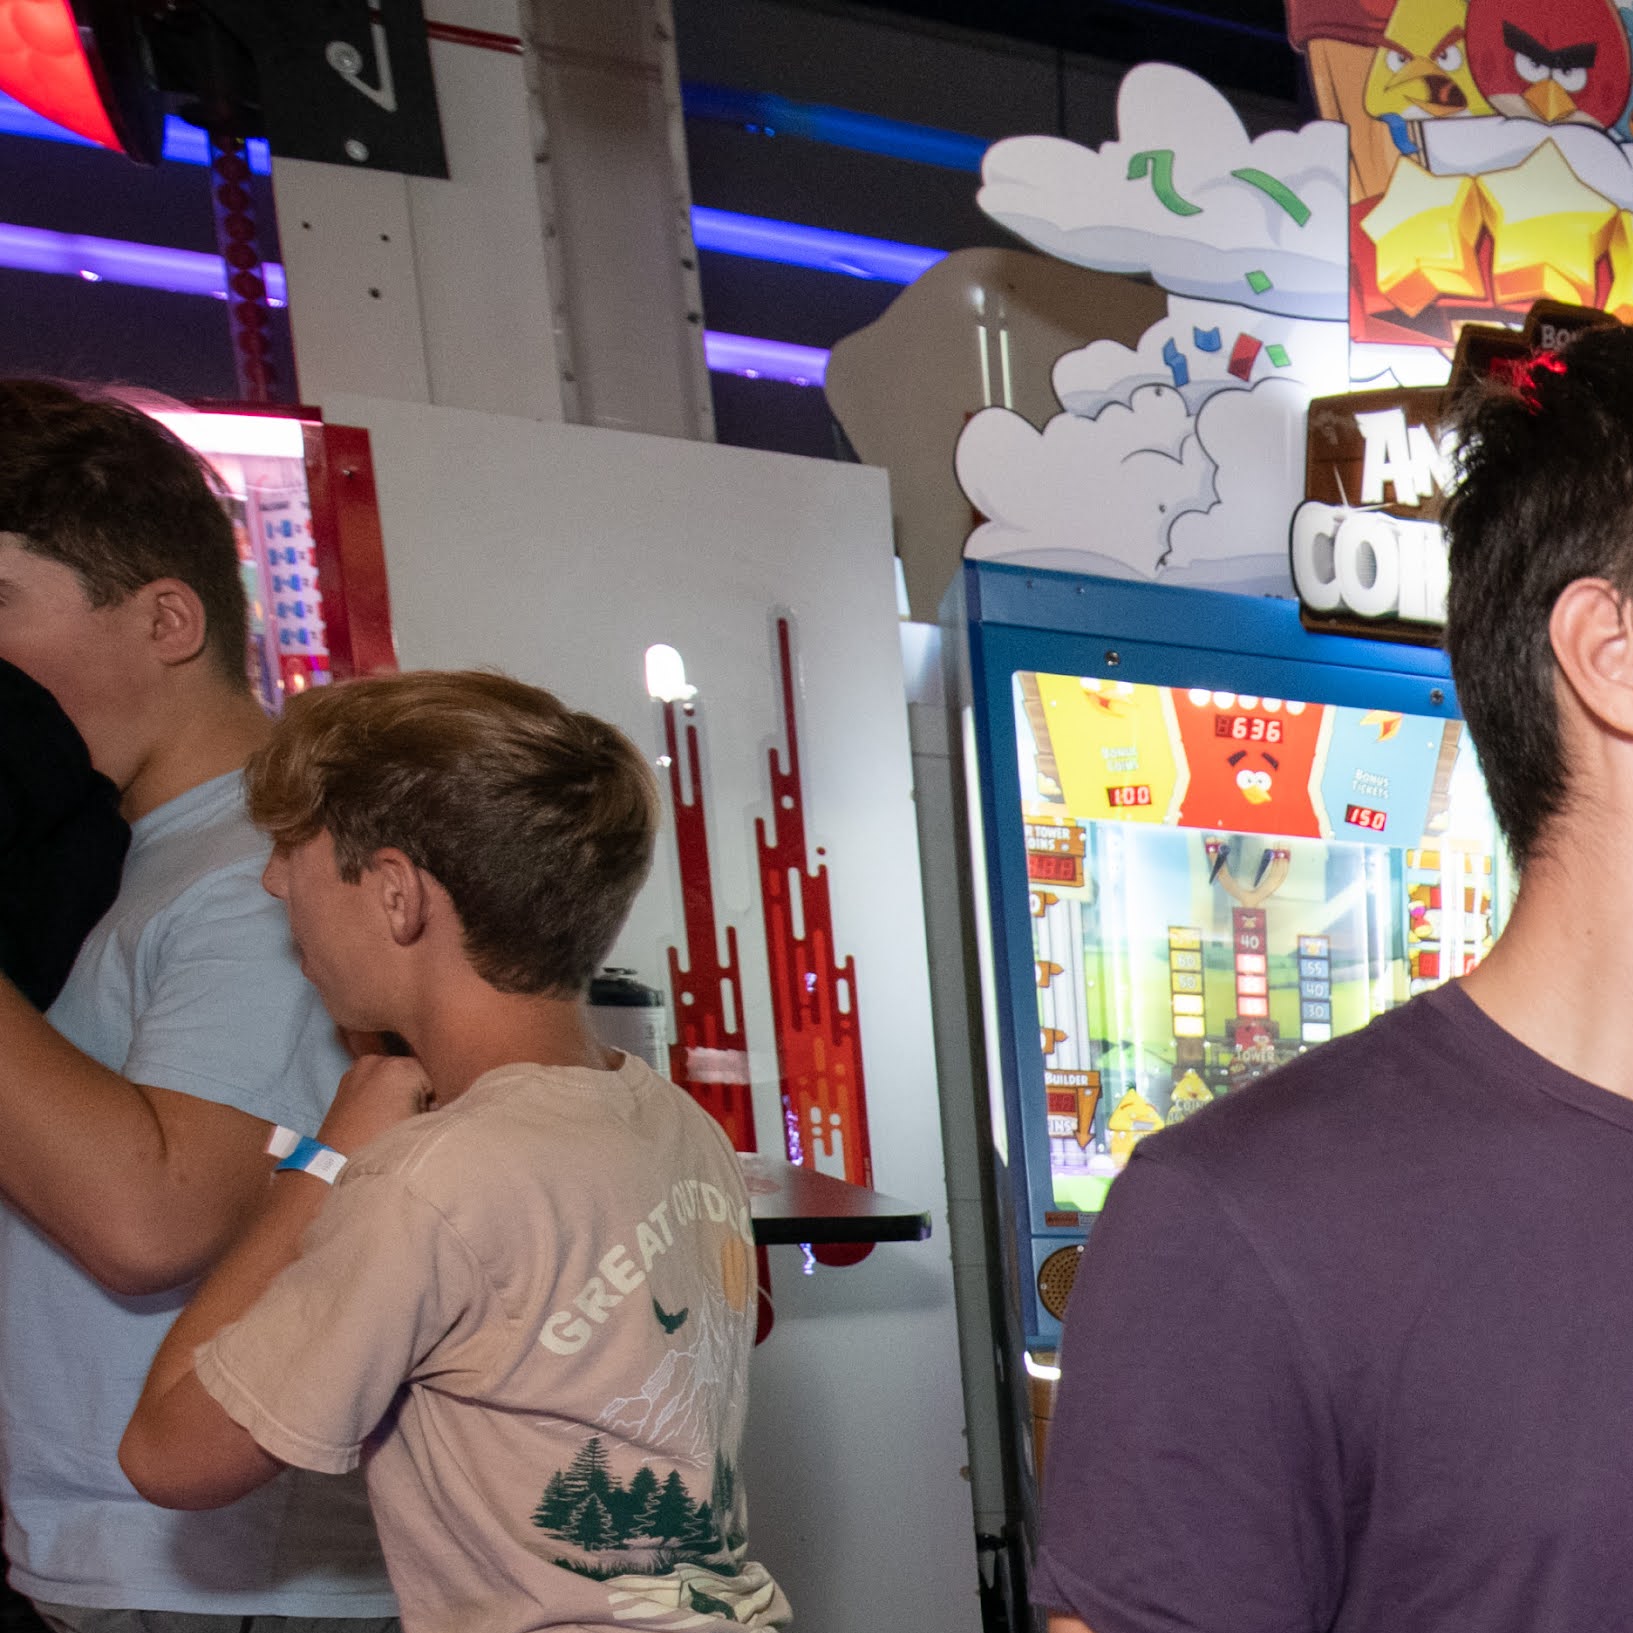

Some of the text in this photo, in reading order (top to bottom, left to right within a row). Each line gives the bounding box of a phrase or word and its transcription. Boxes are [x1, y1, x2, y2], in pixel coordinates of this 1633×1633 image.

[1231, 717, 1282, 741] 636
[1111, 786, 1150, 806] 100
[1349, 807, 1386, 830] 150
[1035, 827, 1070, 841] TOWER
[1240, 934, 1260, 949] 40
[1045, 1071, 1088, 1085] BUILDER
[539, 1200, 675, 1355] GREAT
